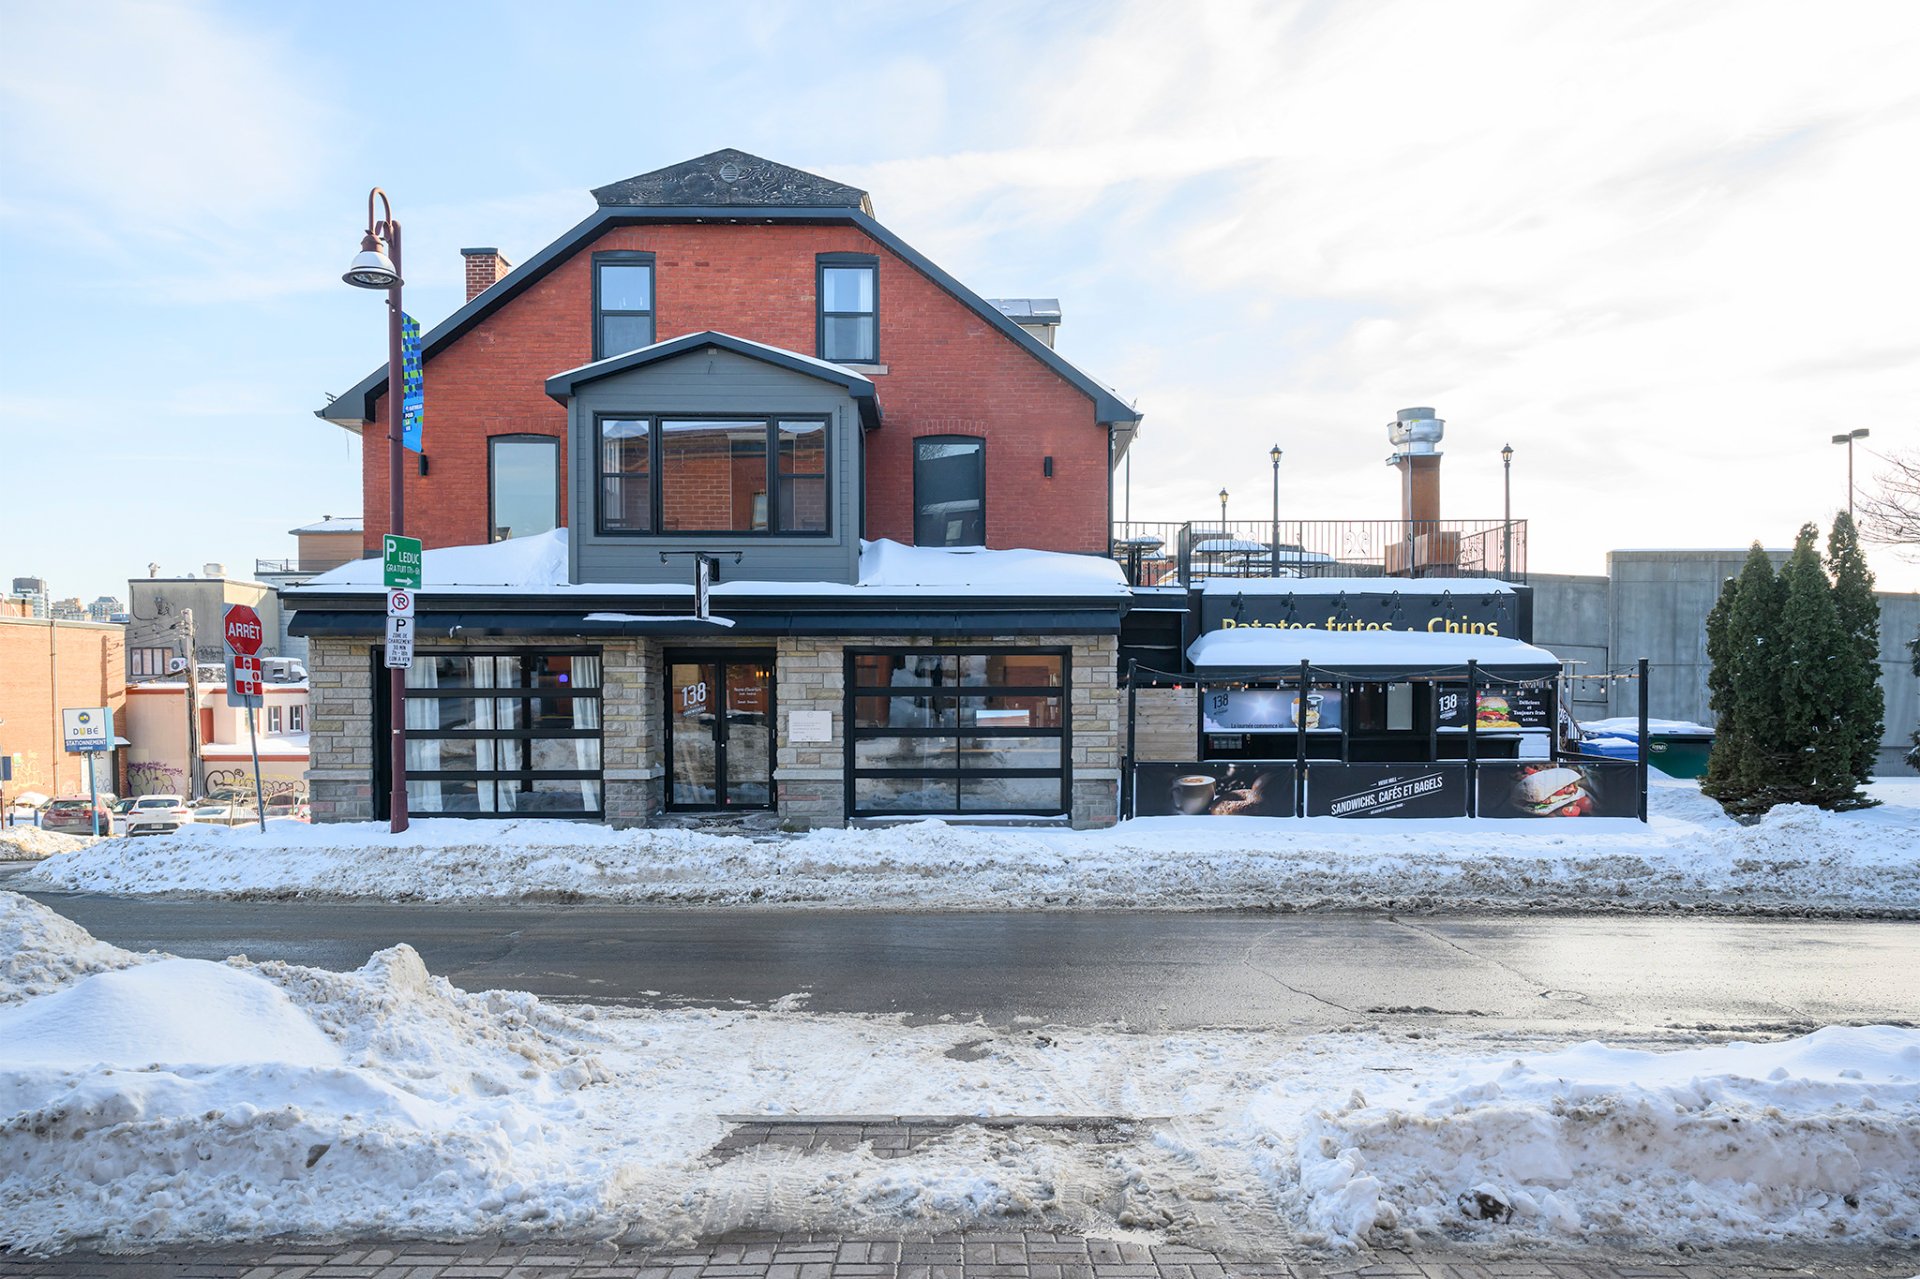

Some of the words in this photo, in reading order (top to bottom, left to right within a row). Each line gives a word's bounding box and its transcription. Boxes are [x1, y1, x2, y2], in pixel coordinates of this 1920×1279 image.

[386, 539, 397, 561] P
[398, 551, 420, 565] LEDUC
[386, 563, 406, 573] GRATUIT
[228, 621, 261, 640] ARRÊT
[396, 618, 407, 632] P
[1427, 615, 1499, 637] Chips
[681, 682, 707, 707] 138
[1212, 693, 1229, 709] 138
[1439, 693, 1457, 712] 138
[73, 725, 99, 736] DUBÉ
[65, 739, 106, 747] STATIONNEMENT
[1331, 794, 1377, 815] SANDWICHS,
[1378, 785, 1402, 803] CAFÉS
[1403, 783, 1413, 797] ET
[1413, 776, 1443, 794] BAGELS
